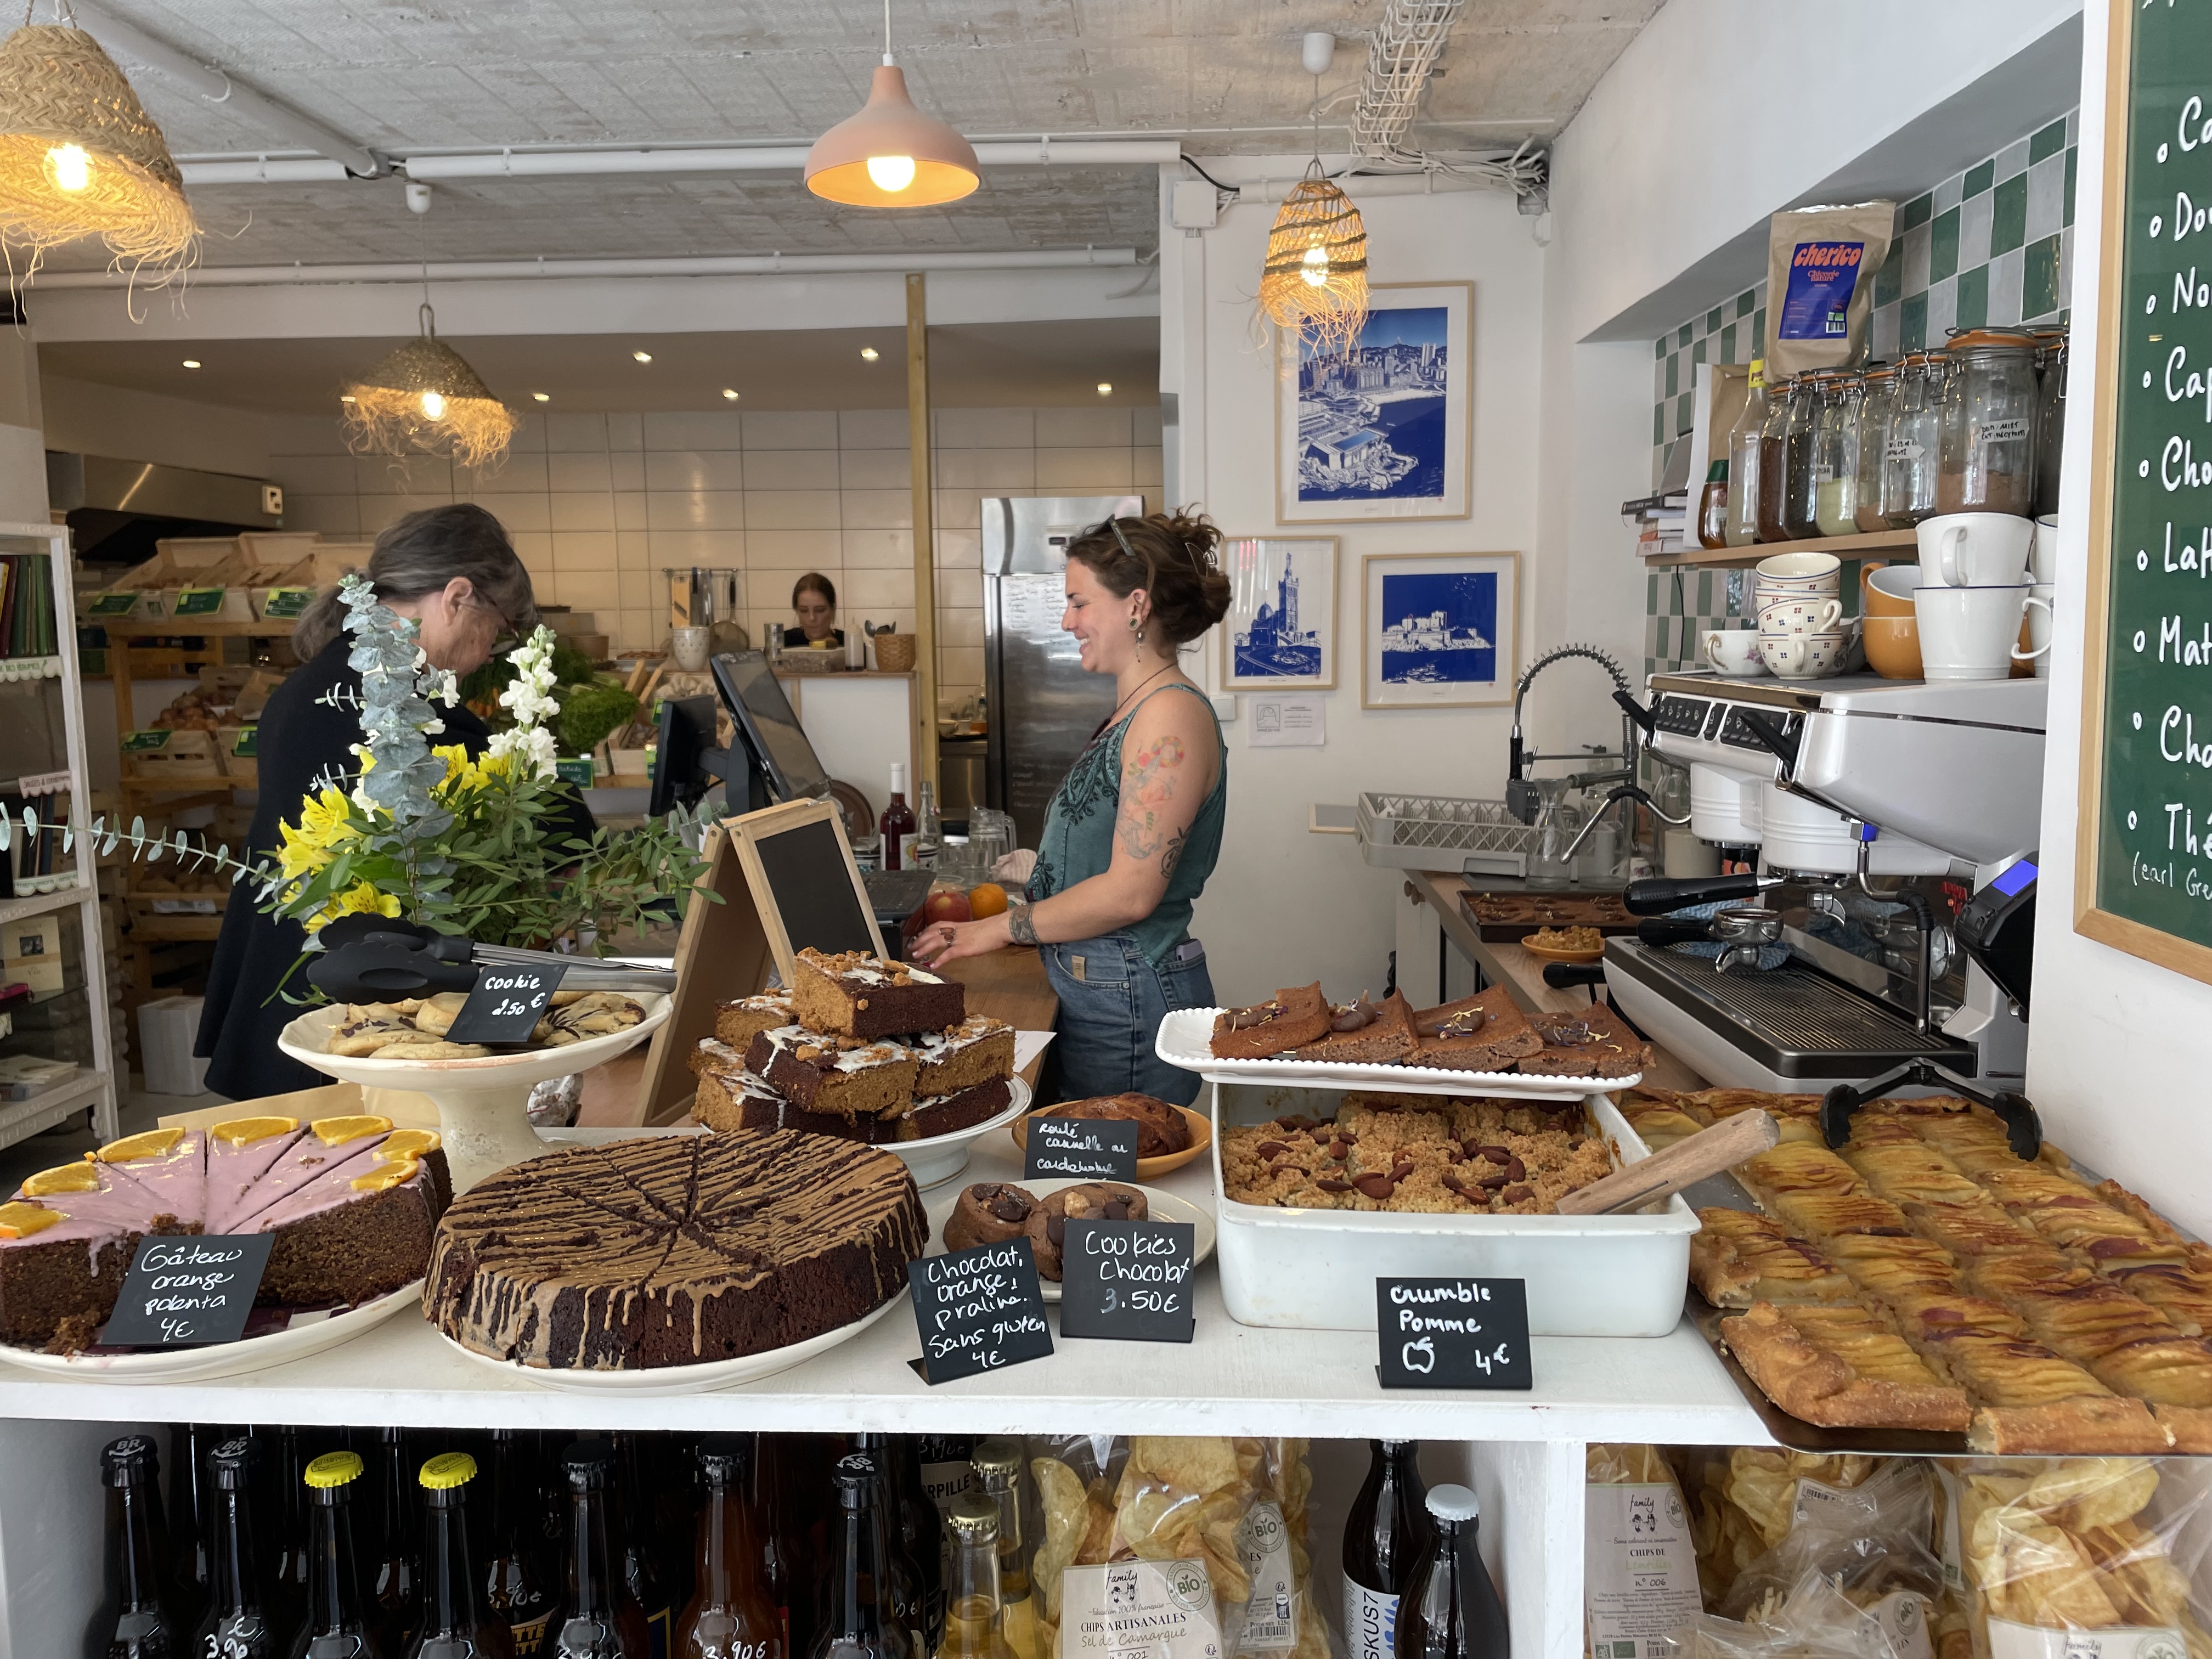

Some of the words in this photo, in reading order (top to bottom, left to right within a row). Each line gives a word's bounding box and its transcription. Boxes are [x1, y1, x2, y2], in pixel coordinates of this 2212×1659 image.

[1794, 244, 1861, 267] cherico
[485, 974, 540, 990] cookie
[1045, 1135, 1104, 1152] cannelle
[1111, 1144, 1128, 1153] ou
[1086, 1231, 1176, 1257] Cookies
[140, 1244, 242, 1272] Gâteau
[1099, 1257, 1190, 1284] Chocolat
[151, 1272, 235, 1291] orange
[145, 1295, 226, 1316] polenta
[1100, 1288, 1180, 1313] 3.50€
[161, 1318, 194, 1342] 4€
[992, 1315, 1046, 1345] gluten
[1399, 1308, 1482, 1334] Pomme
[972, 1350, 1006, 1368] 4€
[1475, 1342, 1510, 1375] 4€
[922, 1474, 970, 1499] RPILLE
[1629, 1494, 1655, 1513] family
[1670, 1503, 1681, 1515] BIO
[1255, 1521, 1277, 1538] BIO
[1105, 1569, 1138, 1590] family
[1177, 1578, 1200, 1595] BIO
[1118, 1605, 1136, 1615] 100%
[1137, 1602, 1164, 1613] française
[1081, 1622, 1104, 1633] CHIPS
[1107, 1612, 1187, 1632] ARTISANALES
[1081, 1635, 1096, 1647] Sel
[1099, 1636, 1113, 1646] de
[1118, 1627, 1187, 1646] Camargue
